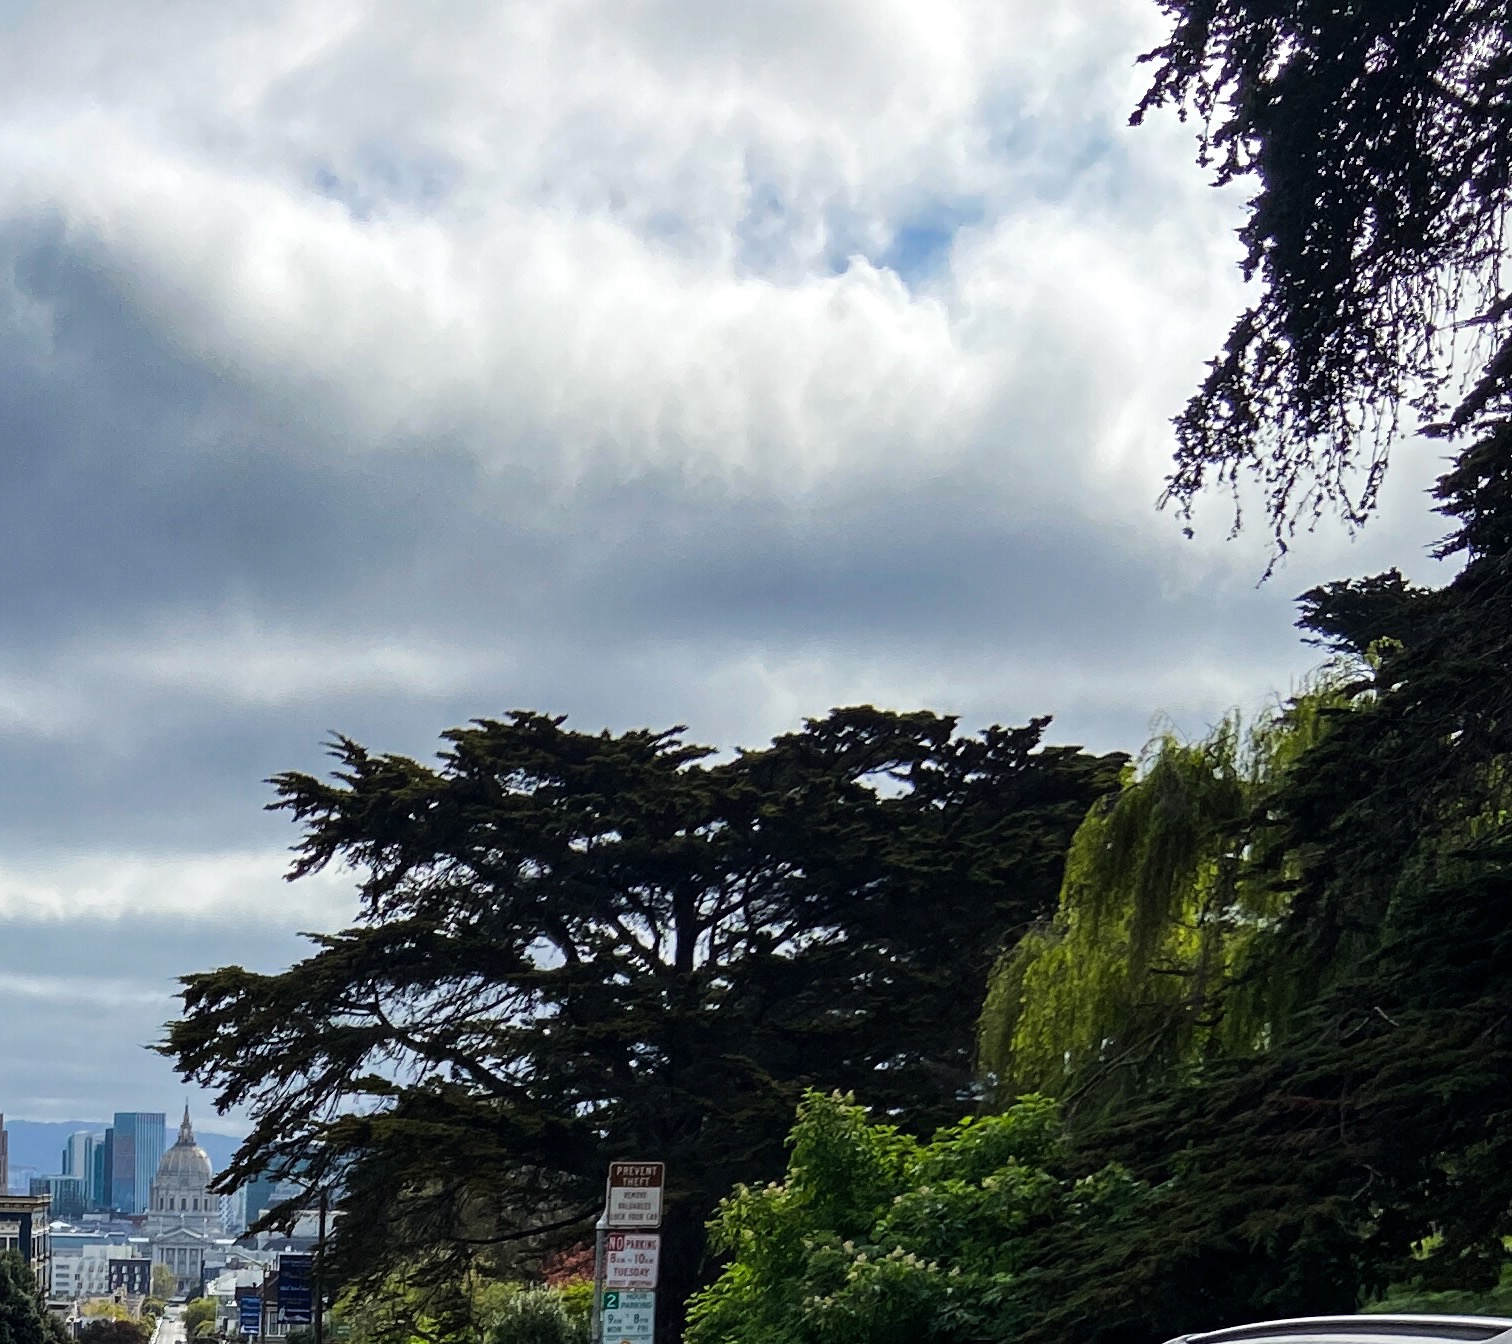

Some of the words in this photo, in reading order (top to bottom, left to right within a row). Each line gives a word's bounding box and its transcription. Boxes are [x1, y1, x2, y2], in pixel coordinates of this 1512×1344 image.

[616, 1165, 657, 1176] PREVENT
[622, 1177, 650, 1186] THEFT
[609, 1236, 623, 1250] NO
[626, 1240, 656, 1250] PARKING
[614, 1267, 649, 1277] TUESDAY
[606, 1293, 616, 1307] 2
